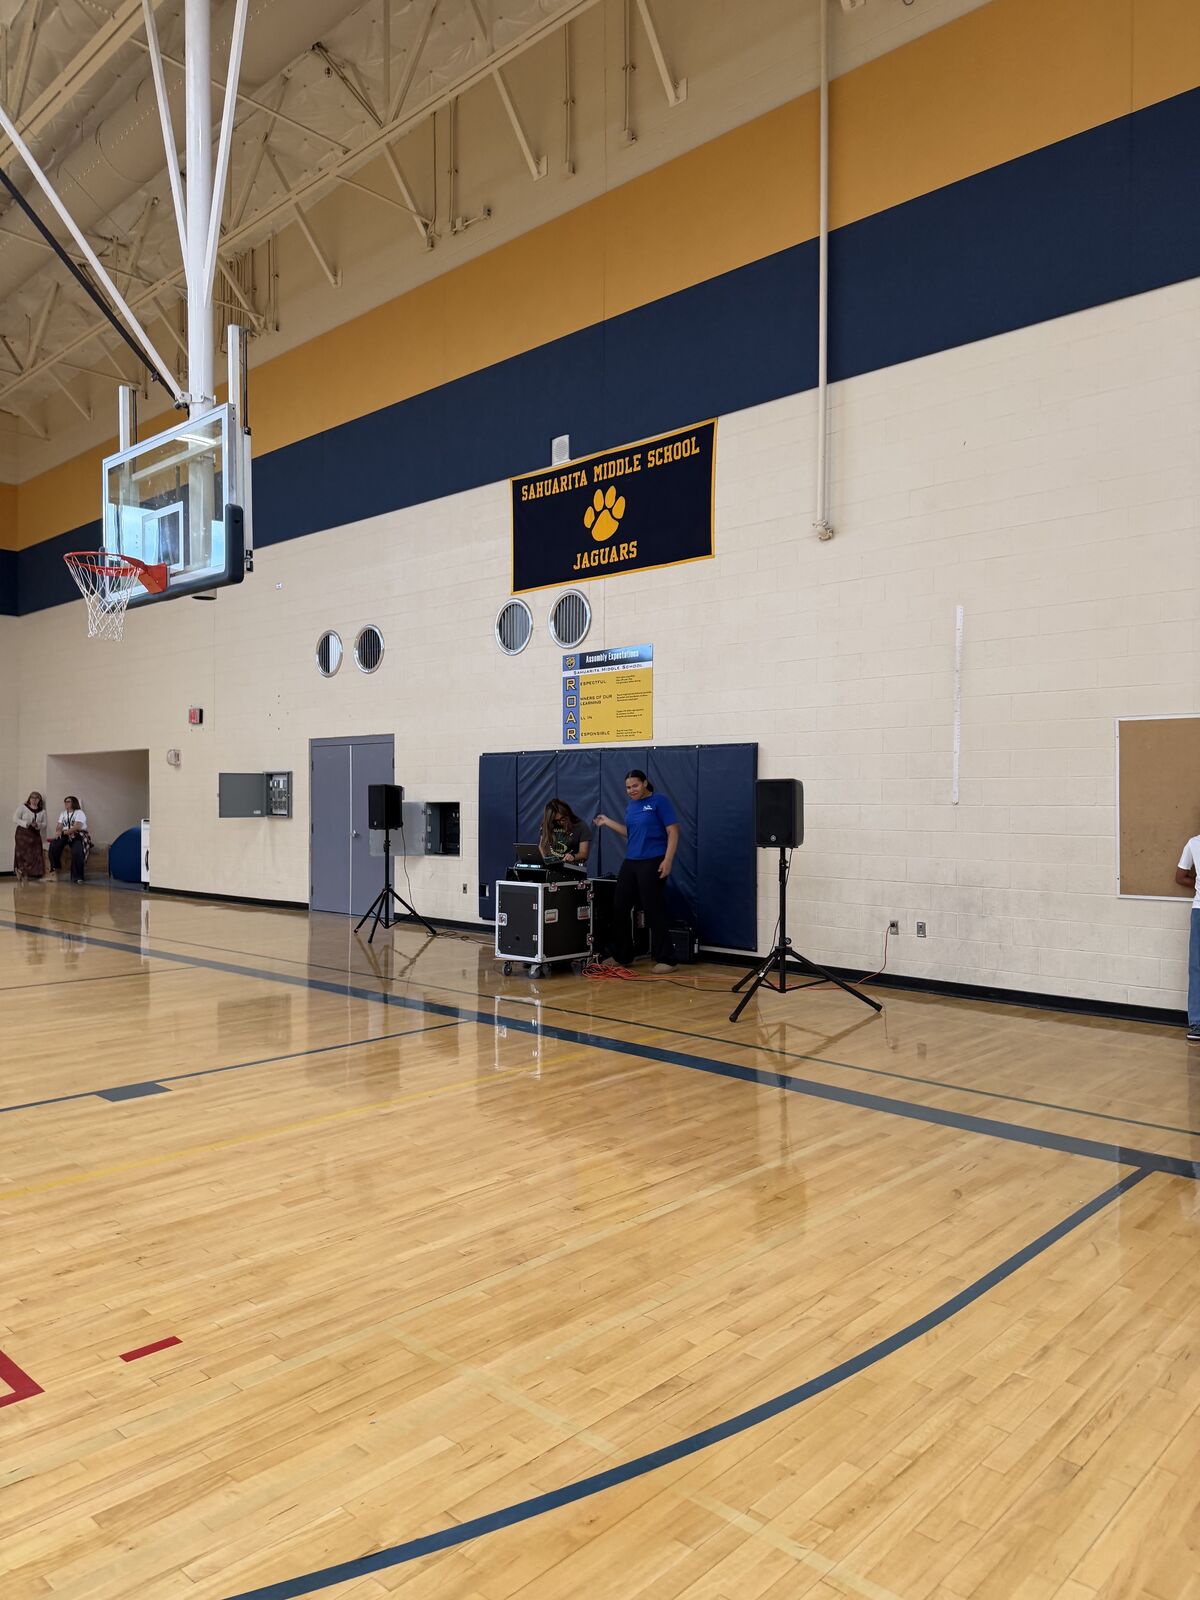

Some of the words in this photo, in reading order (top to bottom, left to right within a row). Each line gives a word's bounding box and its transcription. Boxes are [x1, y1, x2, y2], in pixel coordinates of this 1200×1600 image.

[521, 470, 588, 501] SAHUARITA
[593, 453, 642, 483] MIDDLE
[647, 436, 700, 468] SCHOOL
[573, 541, 638, 570] JAGUARS
[586, 653, 608, 663] Assembly
[608, 650, 640, 661] Expectations
